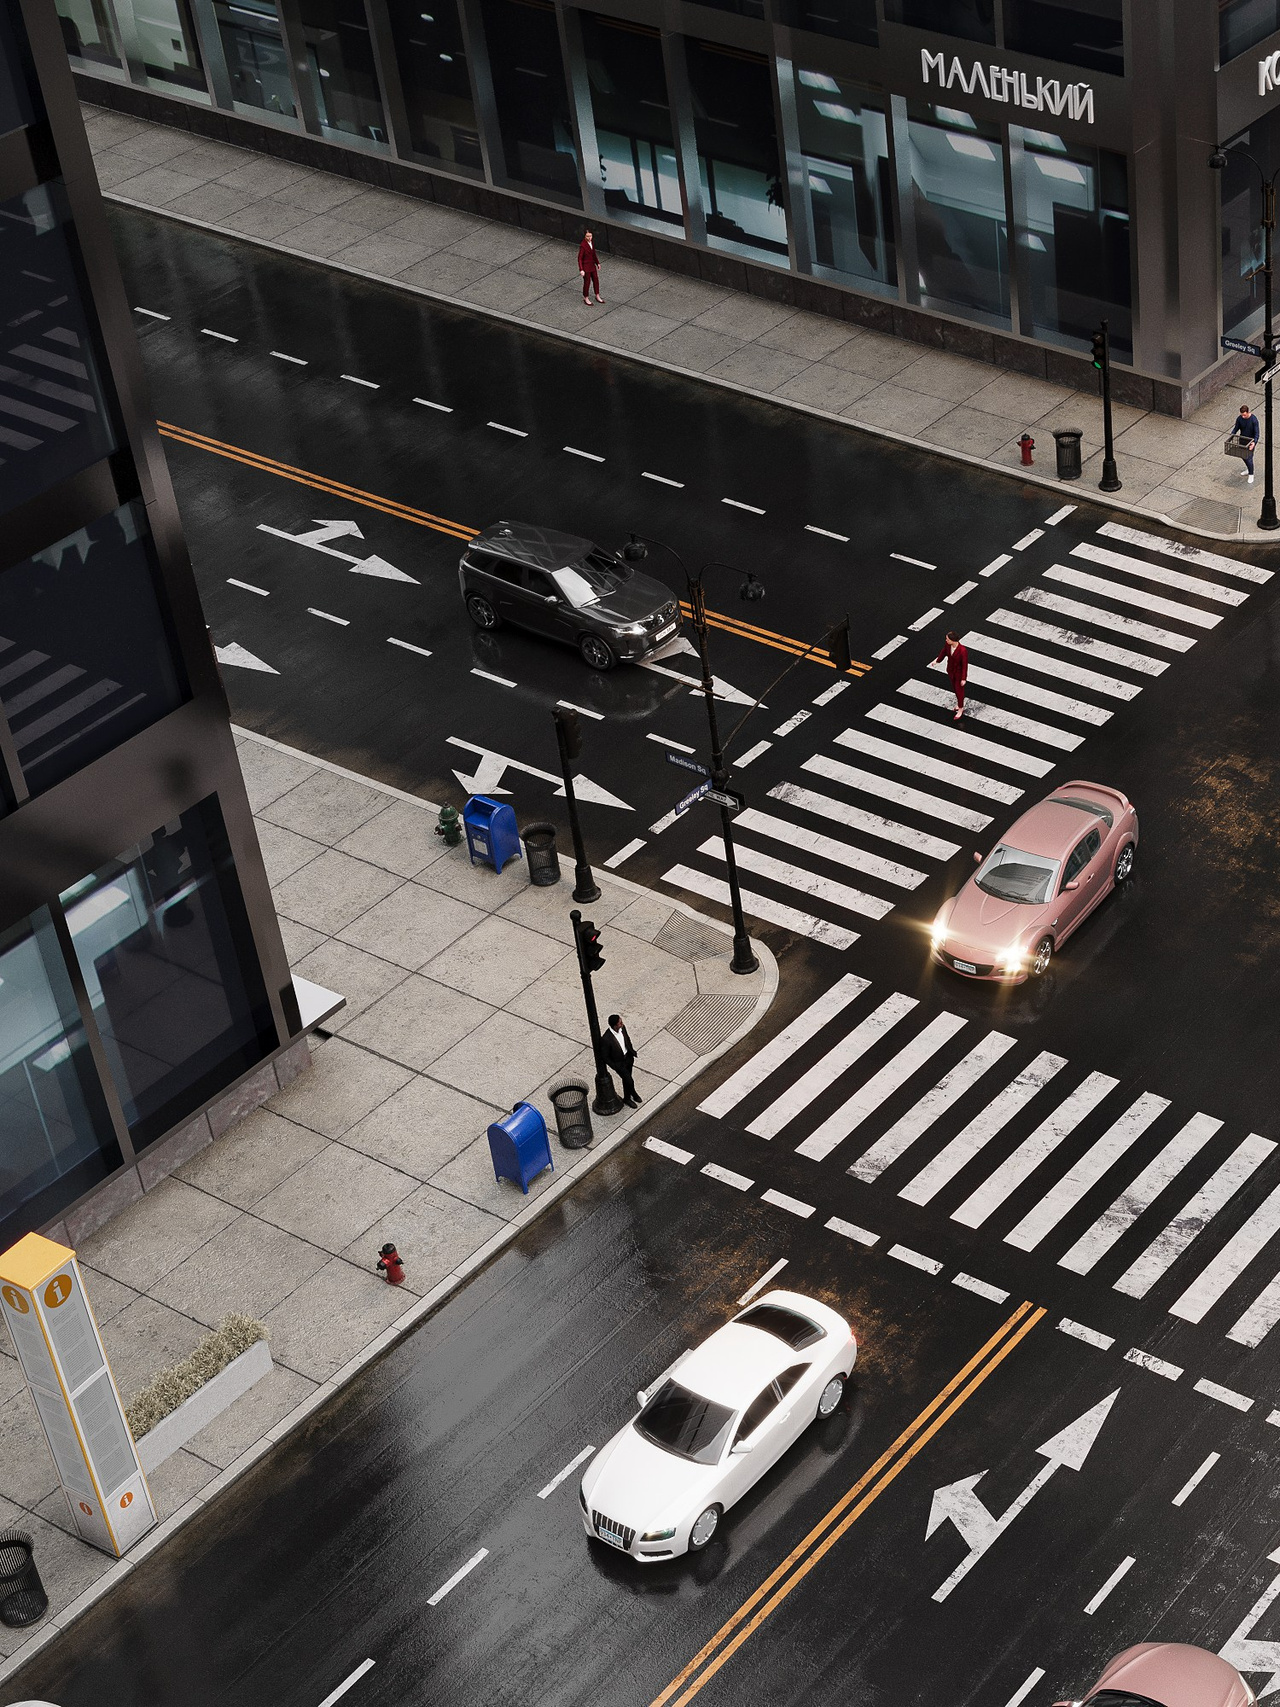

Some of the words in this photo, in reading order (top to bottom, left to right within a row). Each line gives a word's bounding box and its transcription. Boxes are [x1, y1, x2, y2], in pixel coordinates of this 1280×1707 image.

[920, 48, 1095, 124] МАЛЕНЬКИЙ
[1224, 340, 1247, 351] Greeley
[1247, 346, 1256, 354] Sq
[669, 754, 697, 770] Madison
[697, 765, 707, 775] Sq
[679, 789, 700, 809] Greeley
[700, 784, 709, 794] Sq
